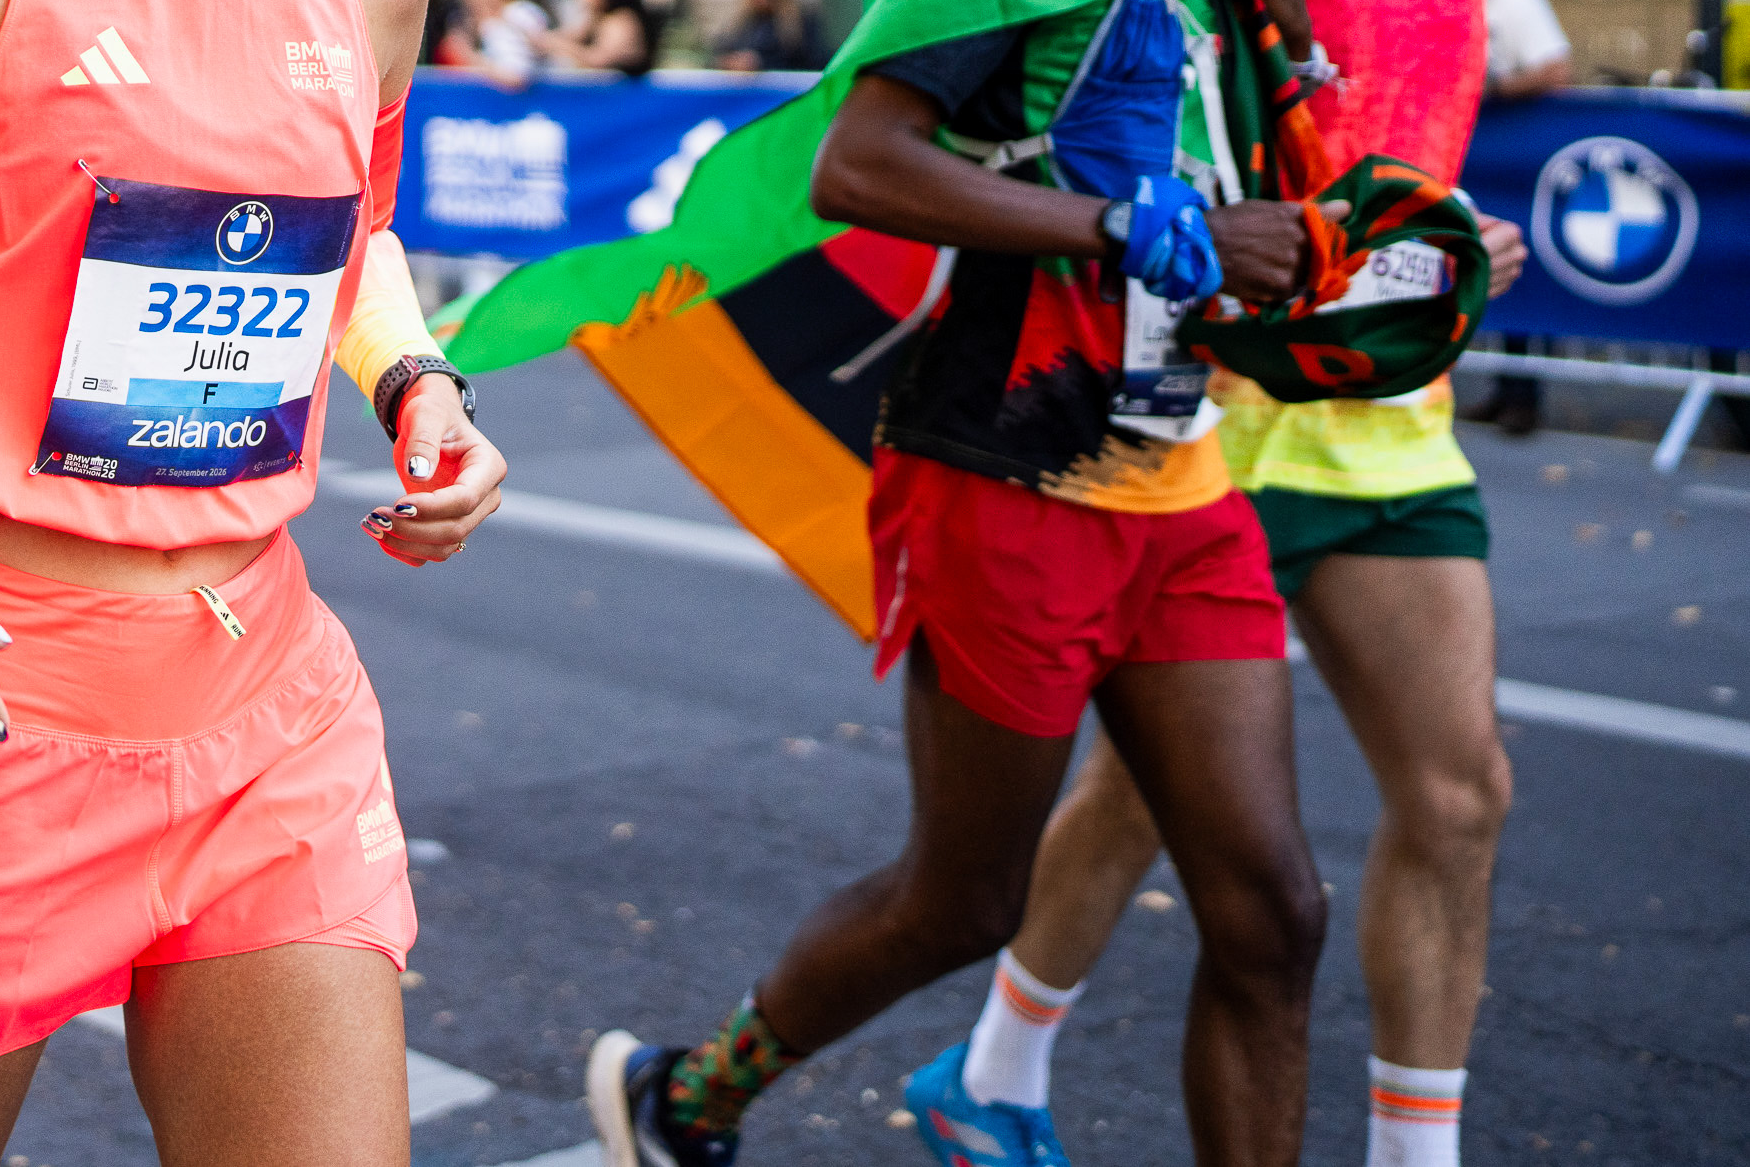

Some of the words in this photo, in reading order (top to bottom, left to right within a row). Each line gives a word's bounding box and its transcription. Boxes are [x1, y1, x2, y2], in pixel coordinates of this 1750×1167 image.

[288, 61, 330, 75] BERL
[291, 77, 354, 98] MARAON
[230, 205, 269, 223] BMW
[138, 282, 310, 338] 32322
[183, 340, 250, 372] Julia
[202, 383, 219, 405] F
[127, 415, 267, 448] zalando
[64, 460, 89, 470] BERLIN
[66, 453, 90, 463] BMW
[103, 459, 118, 469] 20
[62, 465, 101, 477] MARATHON
[100, 469, 116, 479] 26
[155, 468, 167, 476] 27.
[168, 468, 208, 477] September
[209, 468, 227, 476] 2026
